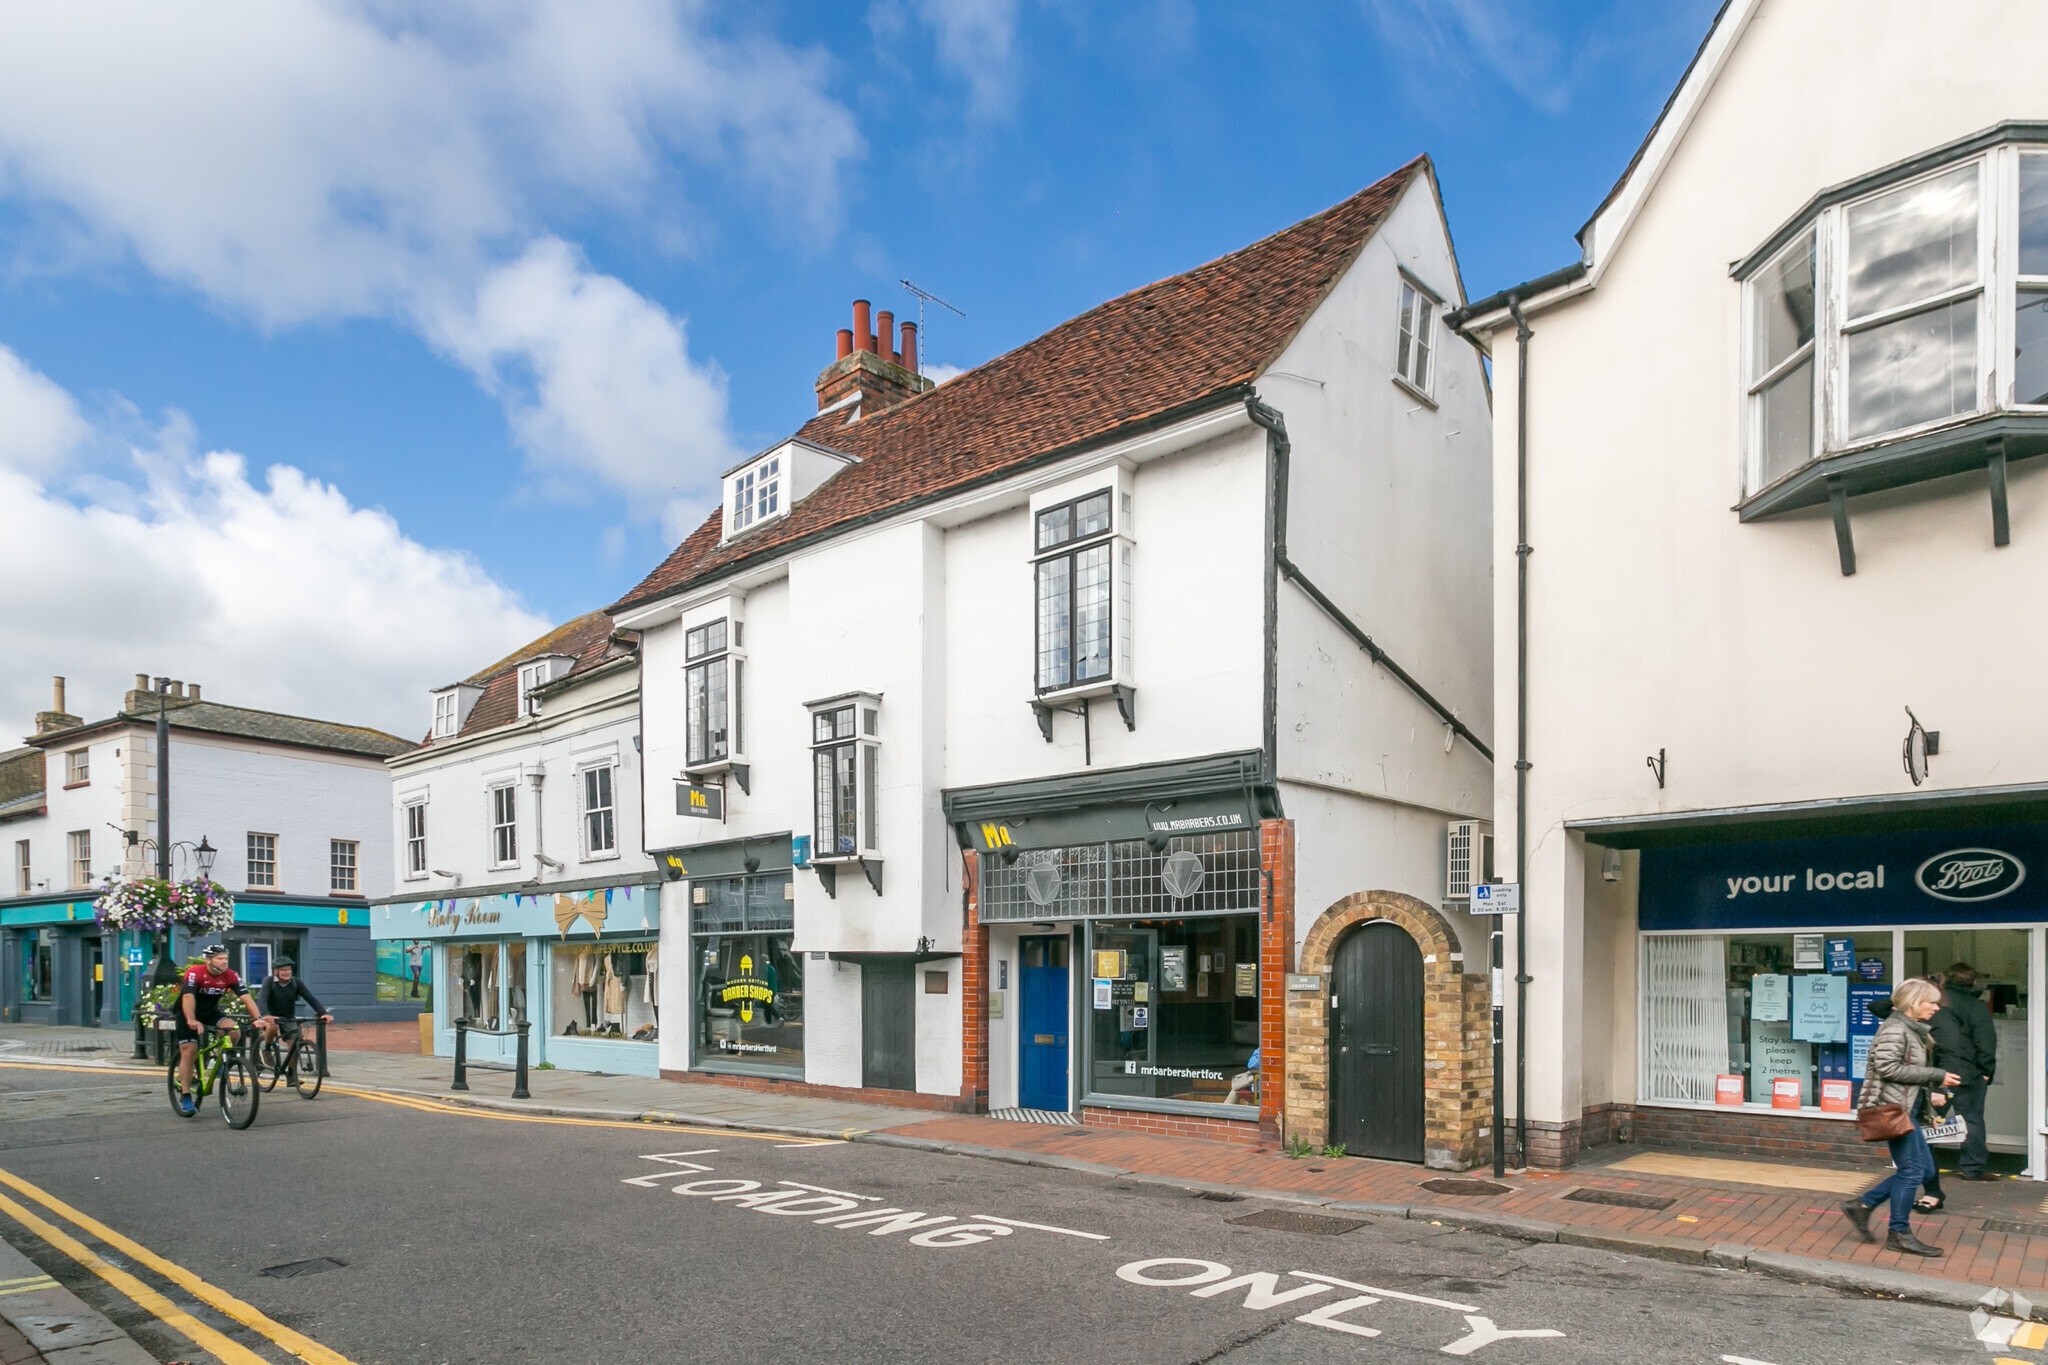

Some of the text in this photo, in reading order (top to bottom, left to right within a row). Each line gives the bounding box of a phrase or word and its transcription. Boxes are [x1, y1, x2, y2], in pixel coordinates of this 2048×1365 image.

[1727, 858, 2004, 899] your local Boots
[722, 985, 773, 1004] BARBER SHOPS
[1759, 1035, 1779, 1045] Stay
[1766, 1046, 1796, 1055] please
[1770, 1057, 1792, 1065] keep
[1762, 1066, 1767, 1074] 2
[621, 1170, 1013, 1248] LOADING
[1115, 1257, 1567, 1356] ONLY
